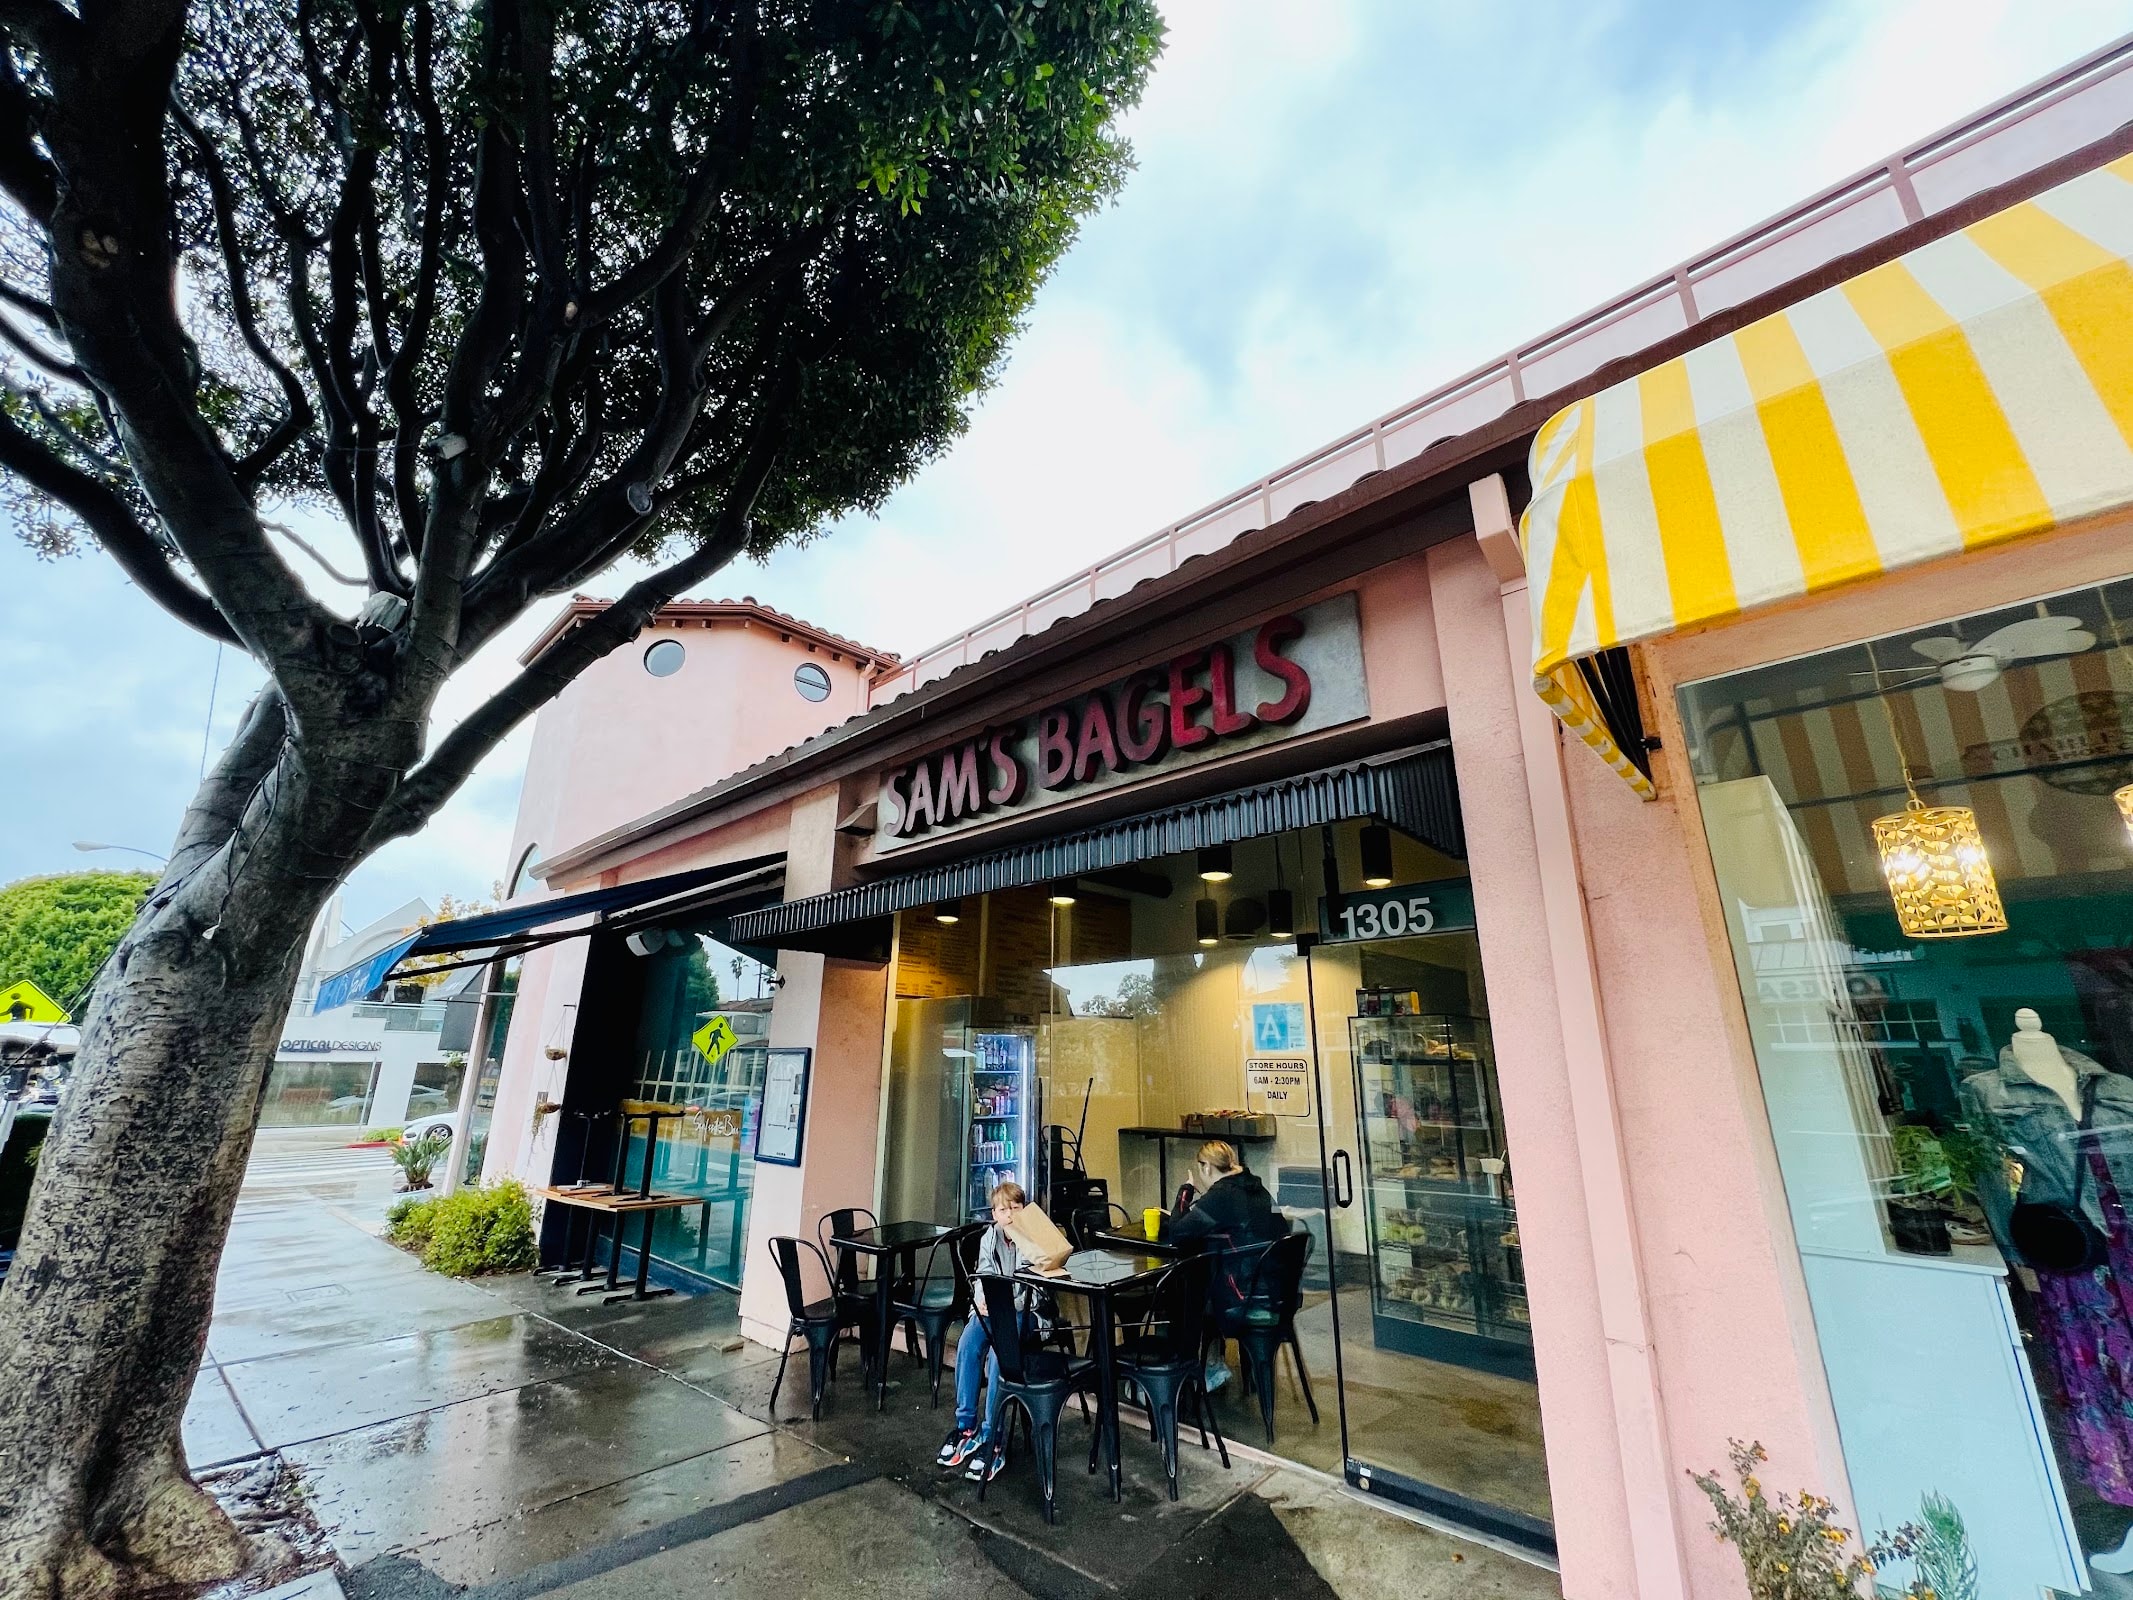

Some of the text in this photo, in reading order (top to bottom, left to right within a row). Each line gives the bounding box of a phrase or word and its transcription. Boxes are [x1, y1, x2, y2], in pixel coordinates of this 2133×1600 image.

[884, 615, 1311, 838] SAM'S BAGELS
[1339, 896, 1434, 940] 1305
[1260, 1013, 1281, 1041] A
[332, 1041, 382, 1052] DESIGNS
[1276, 1062, 1305, 1070] HOURS
[1274, 1076, 1301, 1086] 2:30PM
[1267, 1090, 1288, 1100] DAILY
